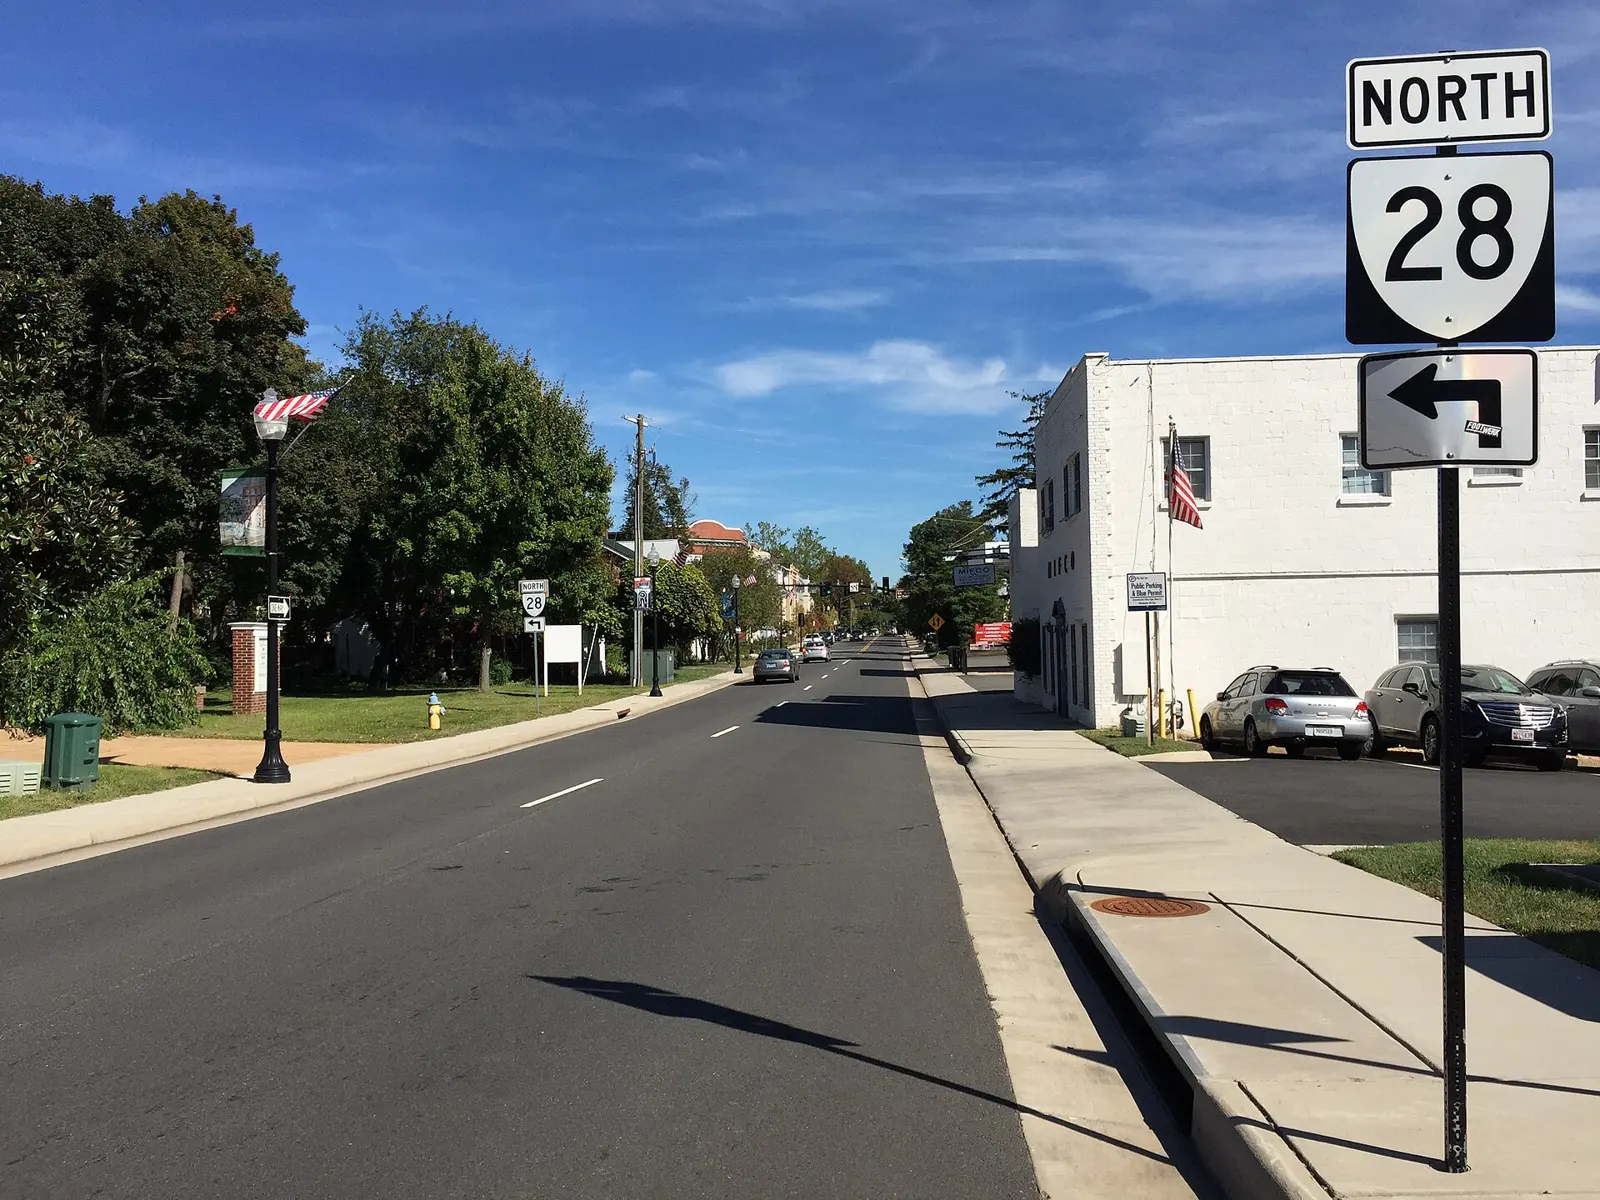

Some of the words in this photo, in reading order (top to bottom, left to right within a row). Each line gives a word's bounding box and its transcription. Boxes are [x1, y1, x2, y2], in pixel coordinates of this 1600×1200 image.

[1362, 70, 1536, 127] NORTH
[1384, 183, 1514, 282] 28
[958, 567, 990, 575] MIFCO
[522, 582, 544, 590] NORTH
[1130, 582, 1145, 590] Public
[1145, 582, 1162, 590] Parking
[526, 596, 542, 610] 28
